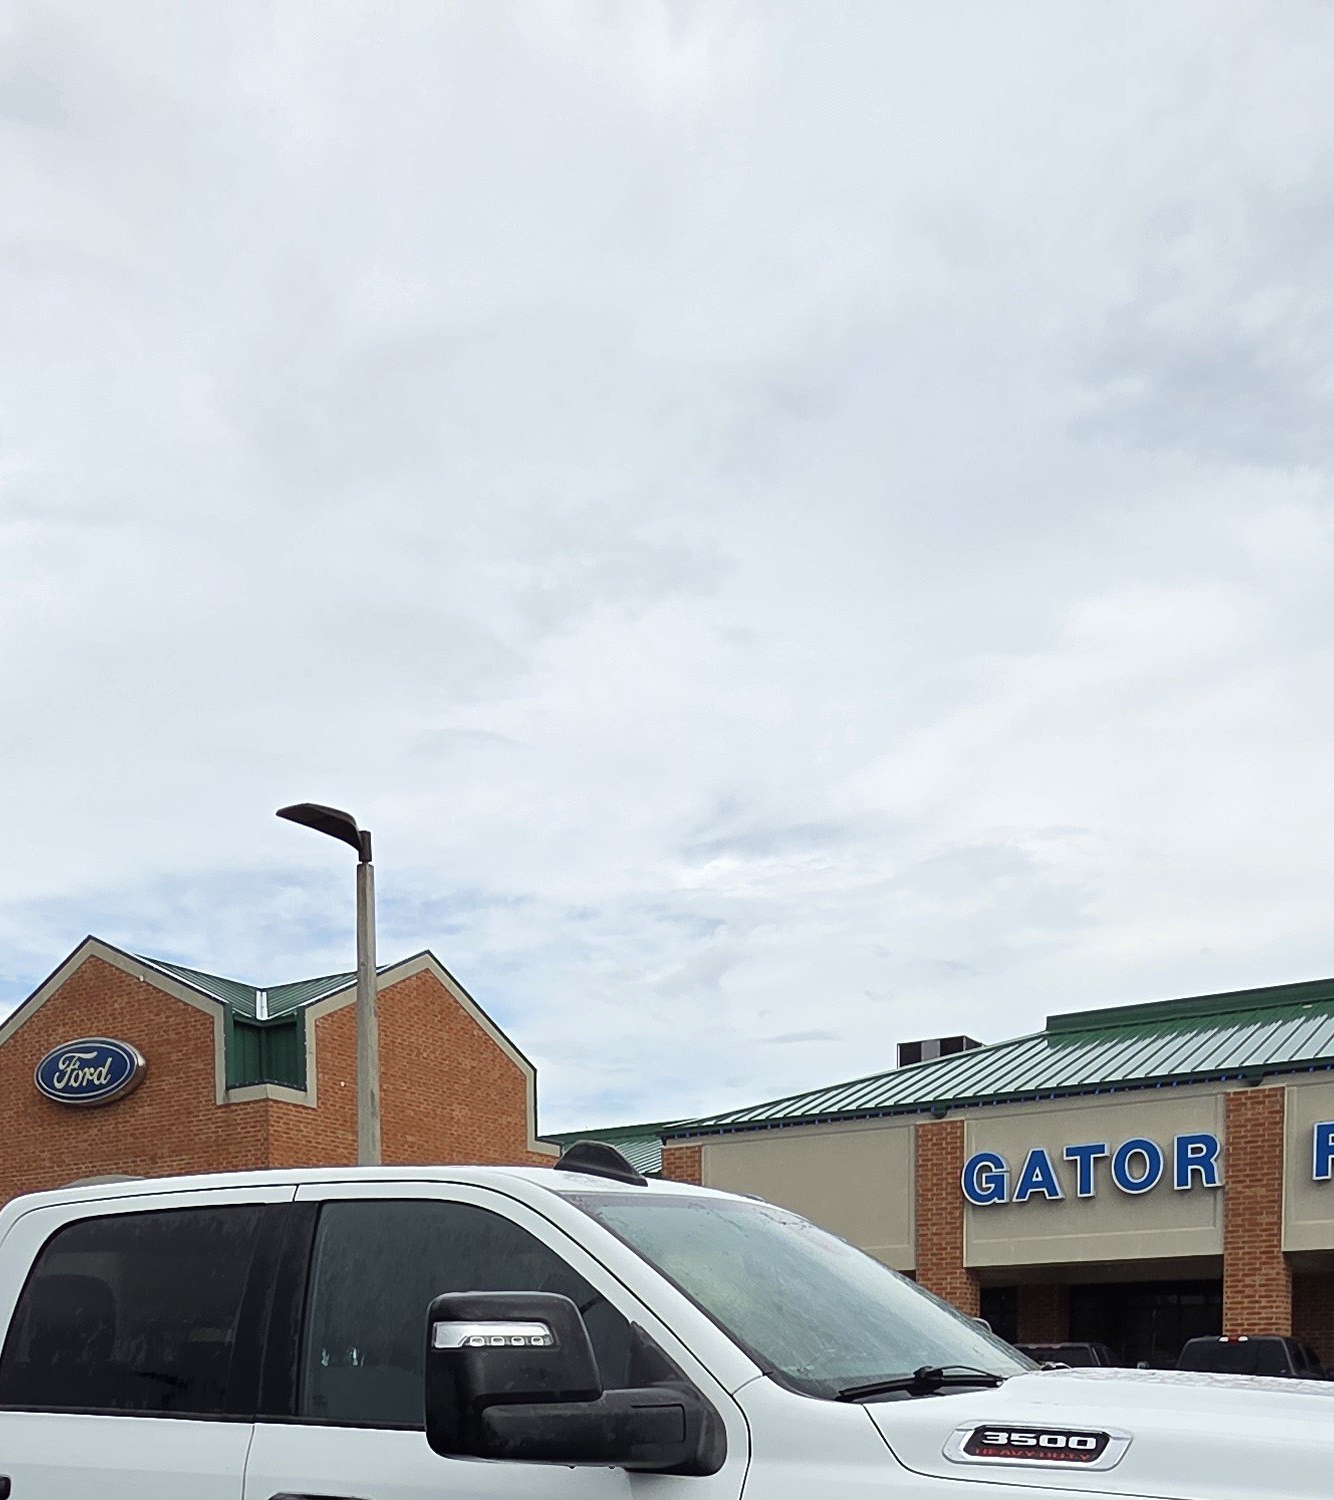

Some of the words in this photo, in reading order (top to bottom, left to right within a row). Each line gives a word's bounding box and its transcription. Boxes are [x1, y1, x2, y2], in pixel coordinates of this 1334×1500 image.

[53, 1051, 113, 1089] Ford
[961, 1132, 1225, 1206] GATOR
[981, 1431, 1097, 1450] 3500
